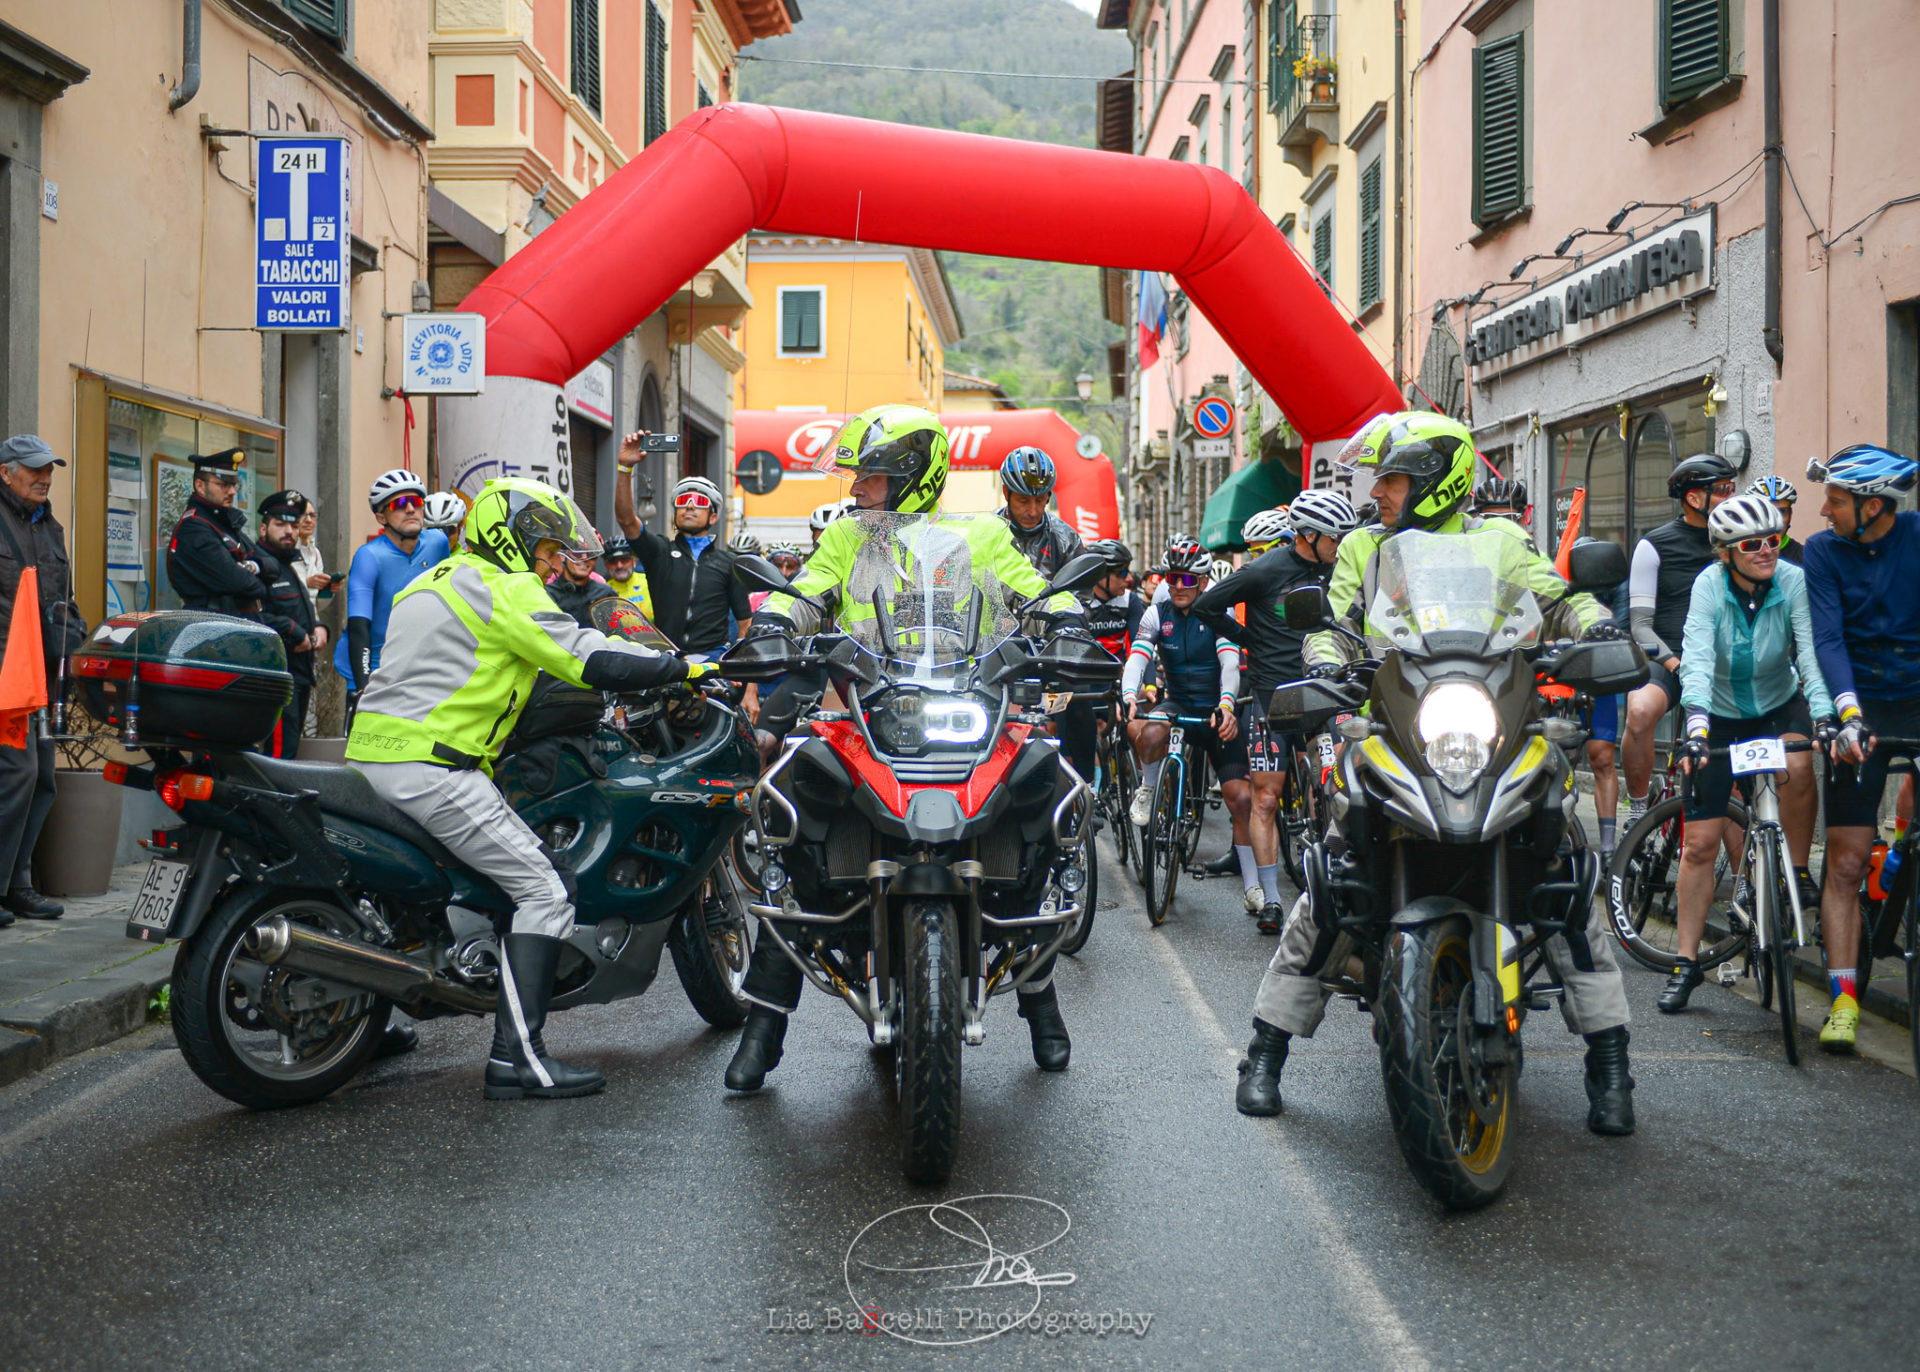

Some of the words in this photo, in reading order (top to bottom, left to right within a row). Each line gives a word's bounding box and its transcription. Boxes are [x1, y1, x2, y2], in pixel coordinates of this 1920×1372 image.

[280, 152, 301, 170] 24
[306, 153, 317, 170] H
[320, 226, 329, 239] 2
[285, 244, 305, 257] SALI
[307, 244, 314, 257] E
[260, 260, 338, 283] TABACCHI
[1565, 229, 1701, 325] PRIMAVERA
[272, 291, 326, 304] VALORI
[267, 310, 330, 323] BOLLATI
[410, 323, 462, 360] RICEVITORIA
[458, 342, 472, 373] LOTTO
[430, 376, 452, 385] 2622
[1745, 747, 1769, 761] 92
[145, 866, 167, 891] AE
[170, 869, 184, 893] 9
[133, 893, 174, 922] 7603
